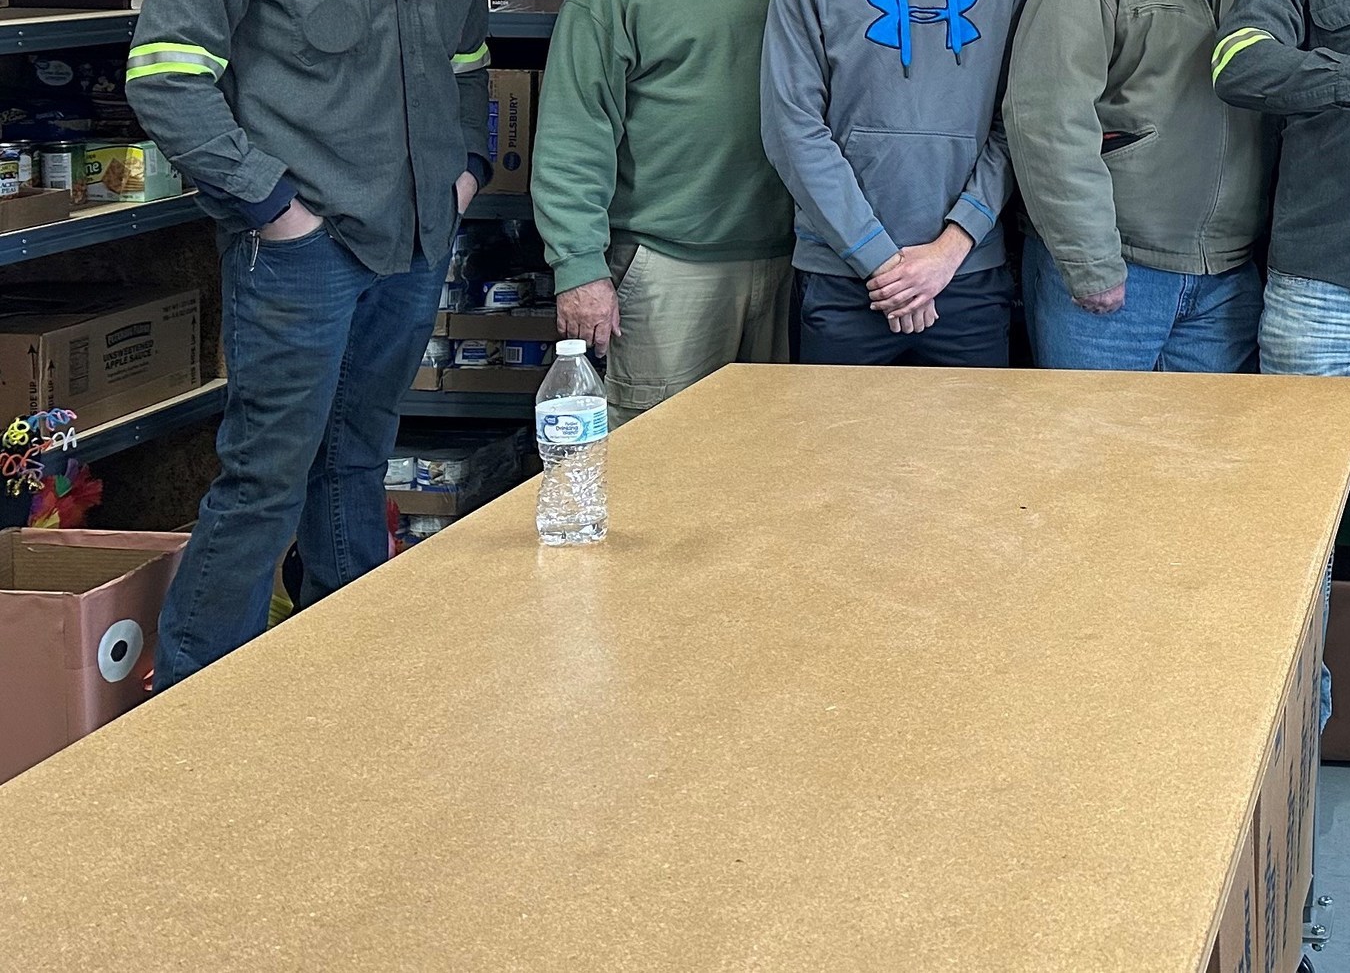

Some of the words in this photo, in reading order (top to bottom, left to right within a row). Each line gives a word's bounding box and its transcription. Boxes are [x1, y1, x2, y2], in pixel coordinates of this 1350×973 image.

[508, 94, 518, 148] PILLSBURY
[103, 339, 154, 362] UNSWEETENED
[105, 358, 128, 371] APPLE
[129, 350, 152, 365] SAUCE
